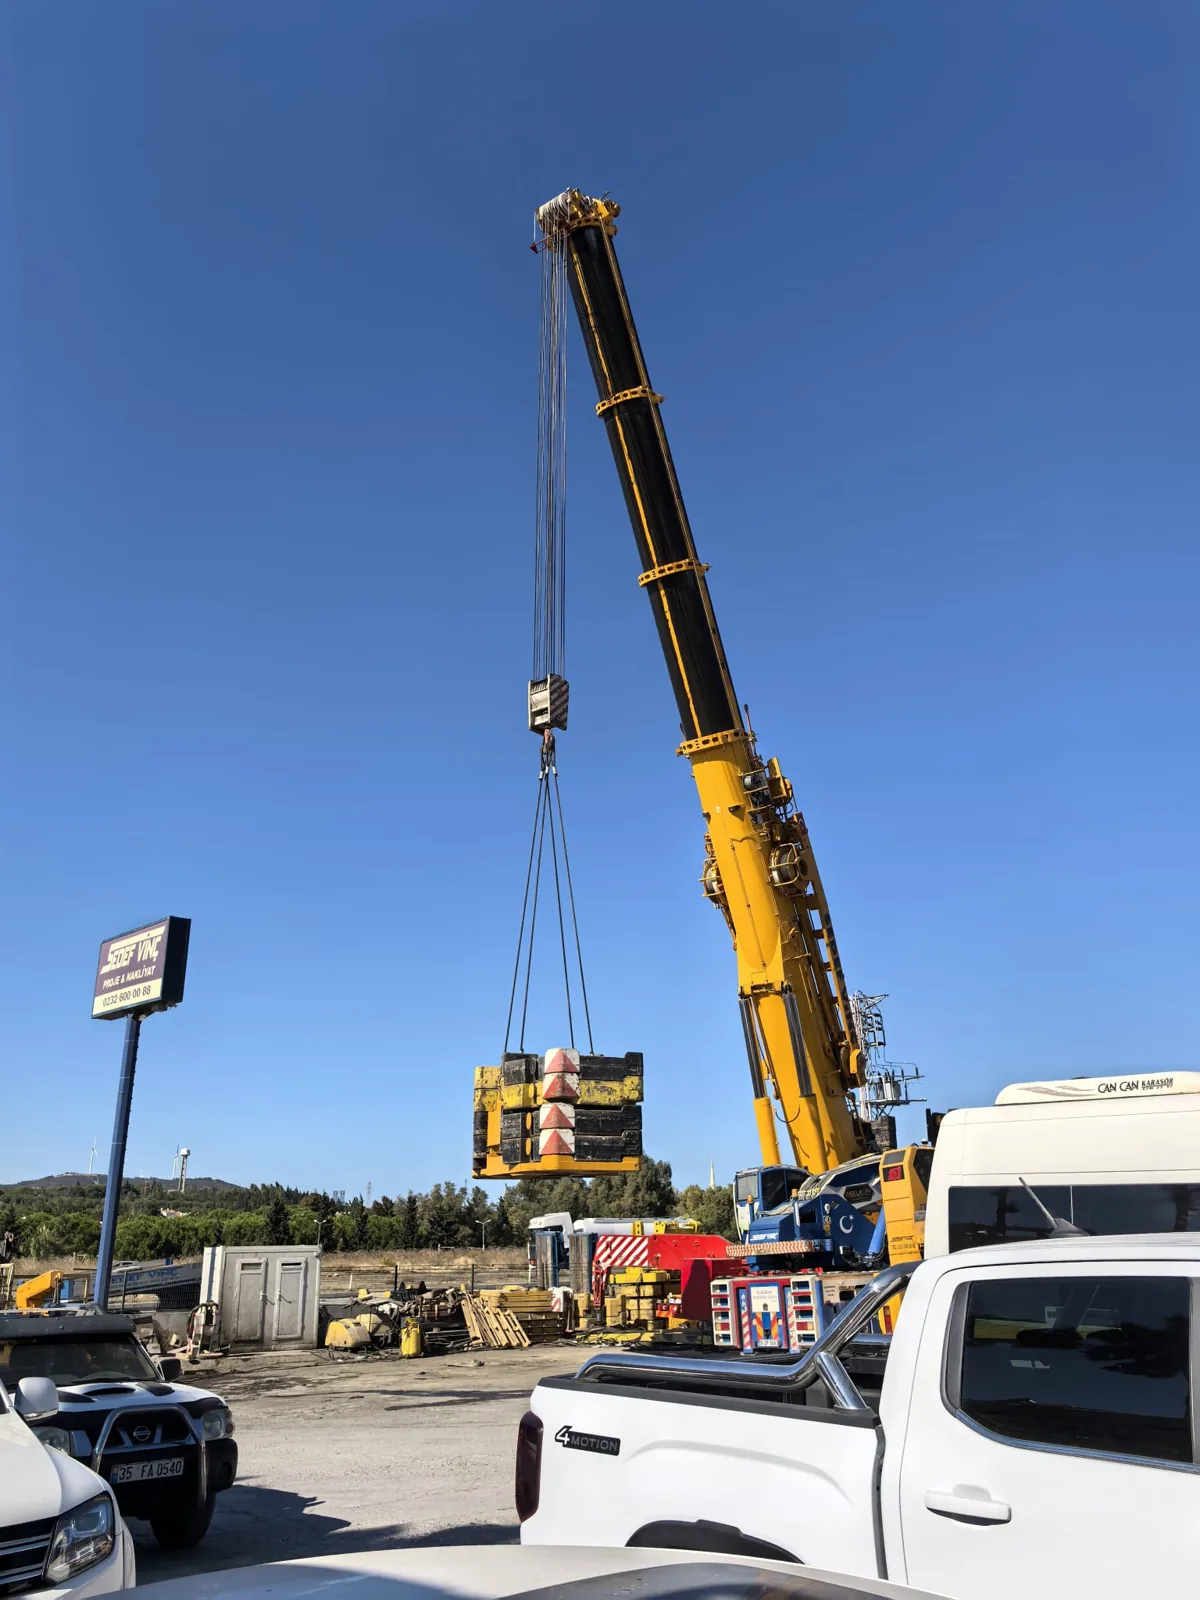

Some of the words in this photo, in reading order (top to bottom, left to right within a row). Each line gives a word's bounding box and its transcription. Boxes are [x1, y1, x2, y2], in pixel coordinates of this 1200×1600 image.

[100, 942, 137, 974] SEDEF
[103, 976, 120, 990] PROJE
[120, 975, 125, 984] &
[126, 965, 156, 982] NAKLİYAT
[103, 994, 117, 1007] 0232
[119, 990, 131, 1003] 600
[132, 988, 141, 998] 00
[142, 985, 151, 996] 88
[1098, 1082, 1117, 1093] CAN
[1119, 1080, 1139, 1091] CAN
[120, 1466, 132, 1480] 35
[141, 1464, 154, 1478] FA
[156, 1460, 182, 1477] 0540
